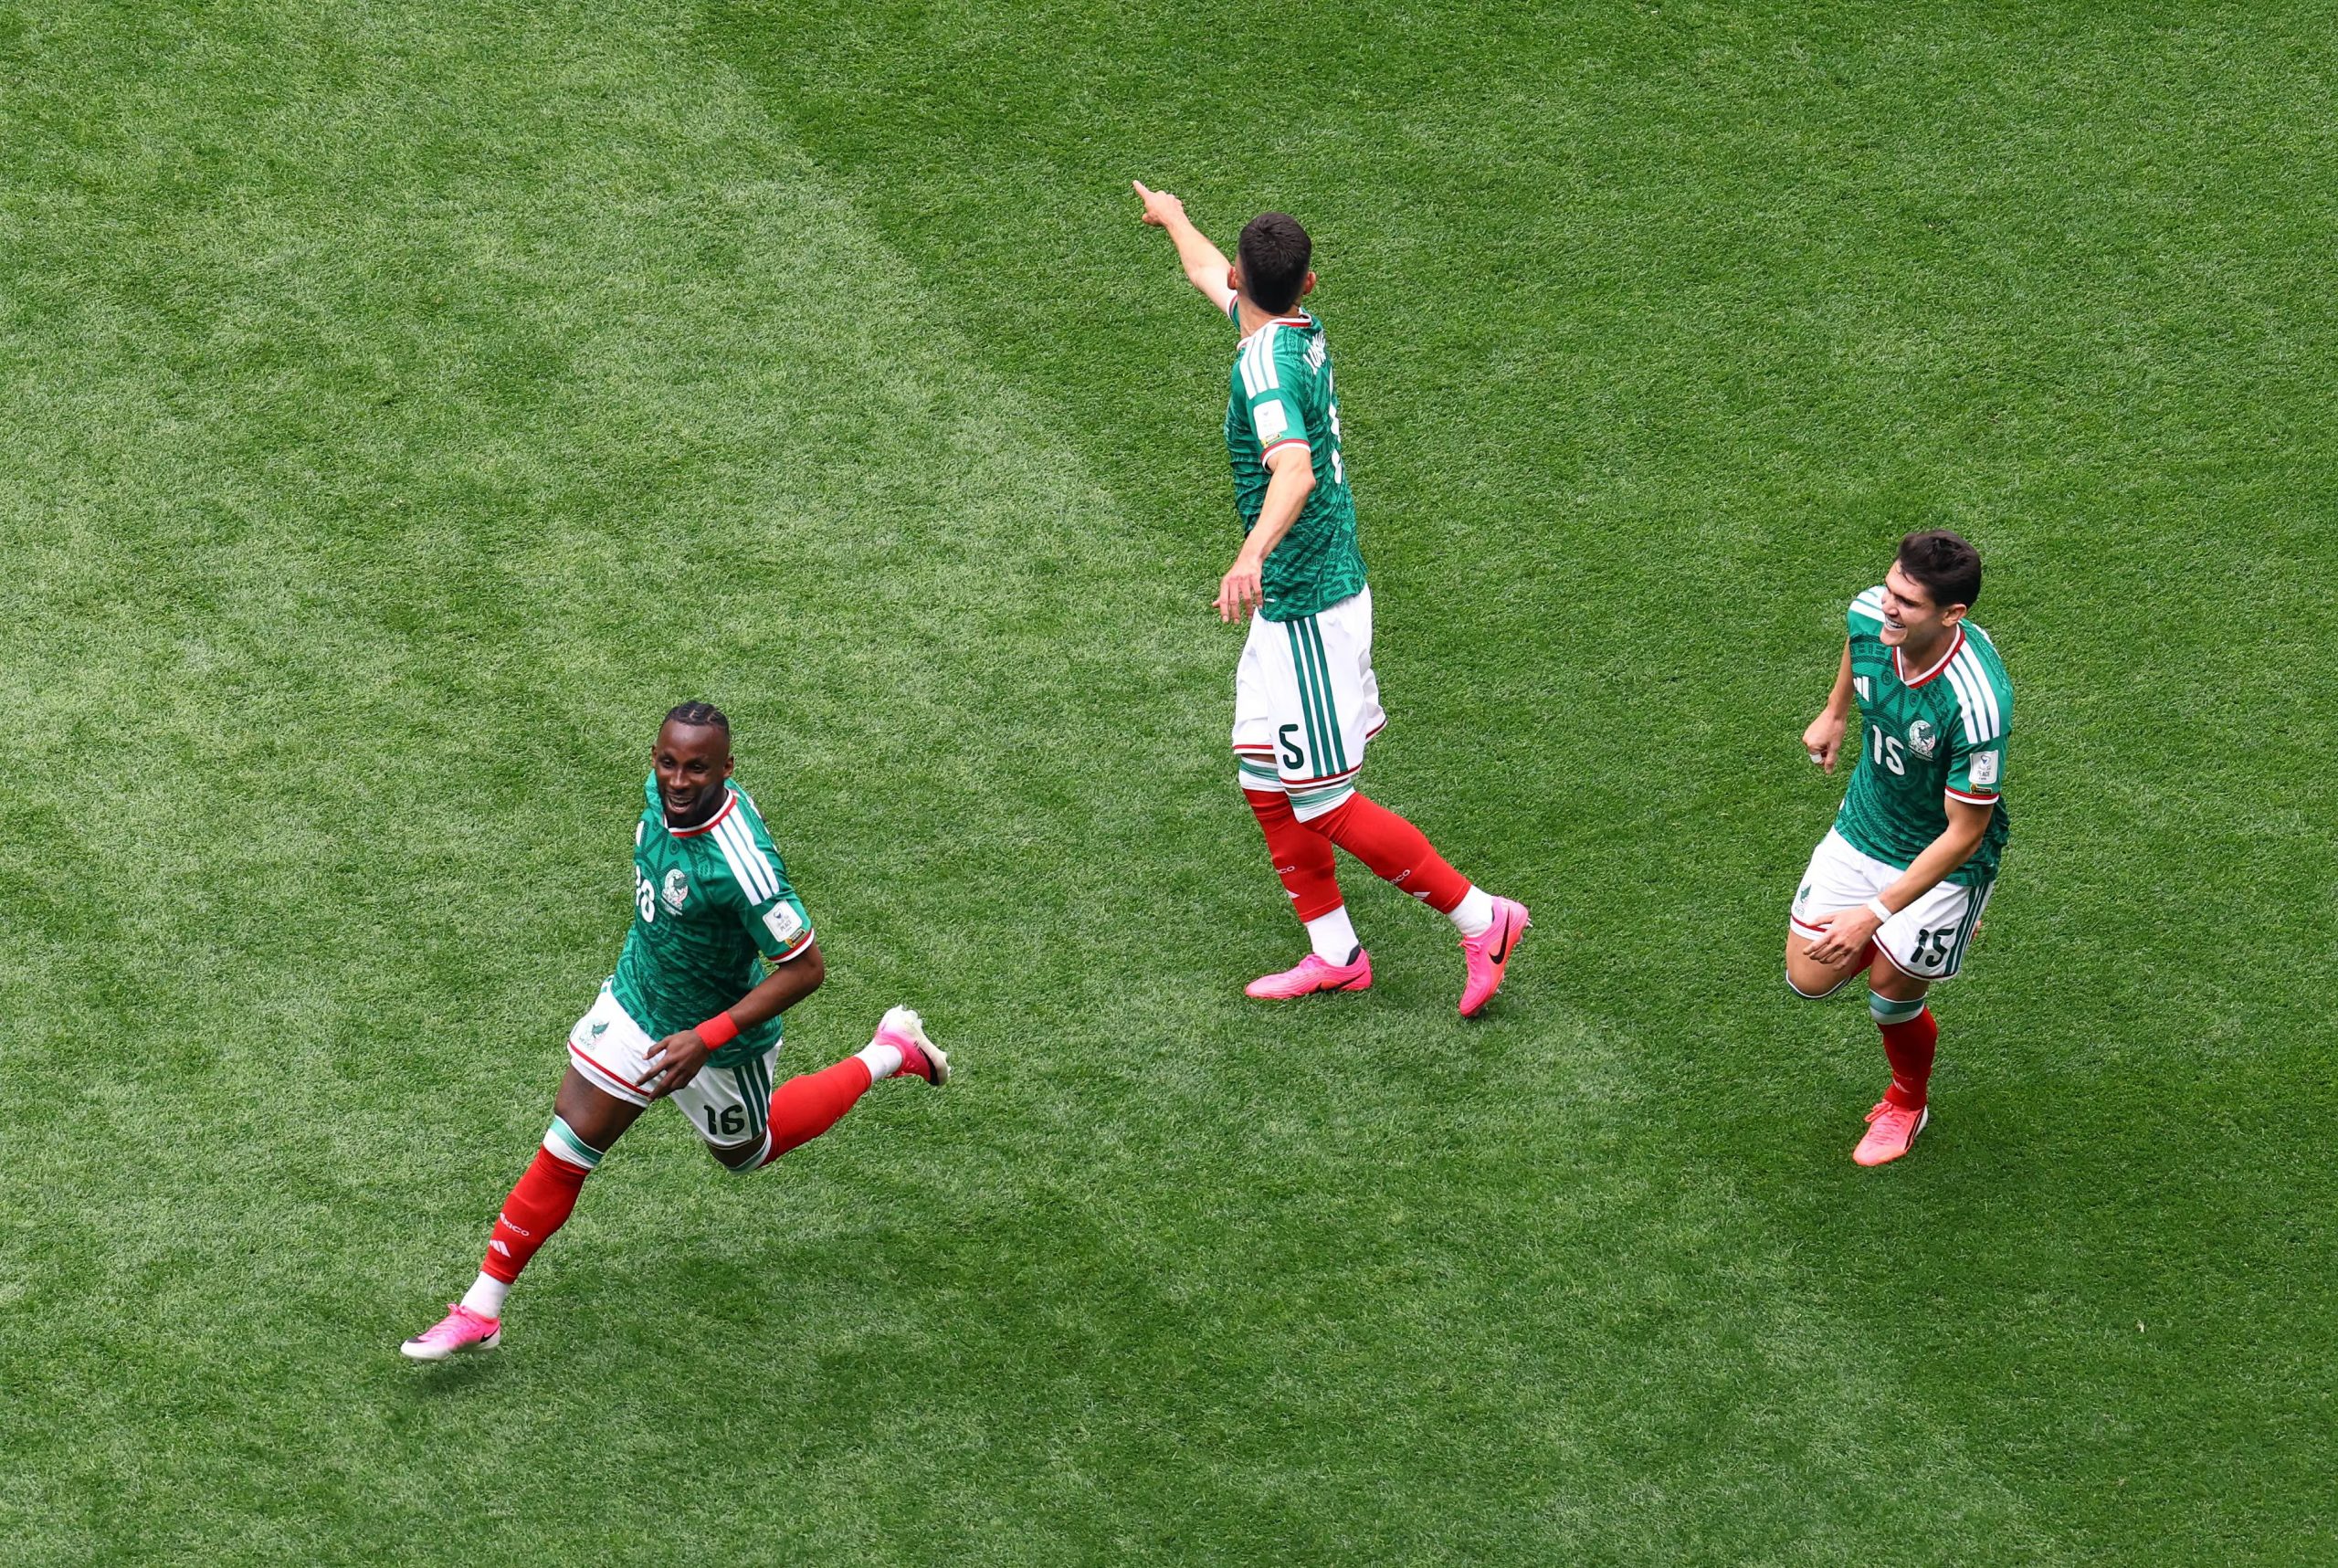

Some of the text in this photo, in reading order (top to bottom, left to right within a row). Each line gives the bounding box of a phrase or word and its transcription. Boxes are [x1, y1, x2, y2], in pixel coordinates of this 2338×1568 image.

[1279, 723, 1305, 770] 5
[1872, 724, 1905, 776] 15
[1910, 928, 1955, 968] 15
[703, 1104, 745, 1135] 16
